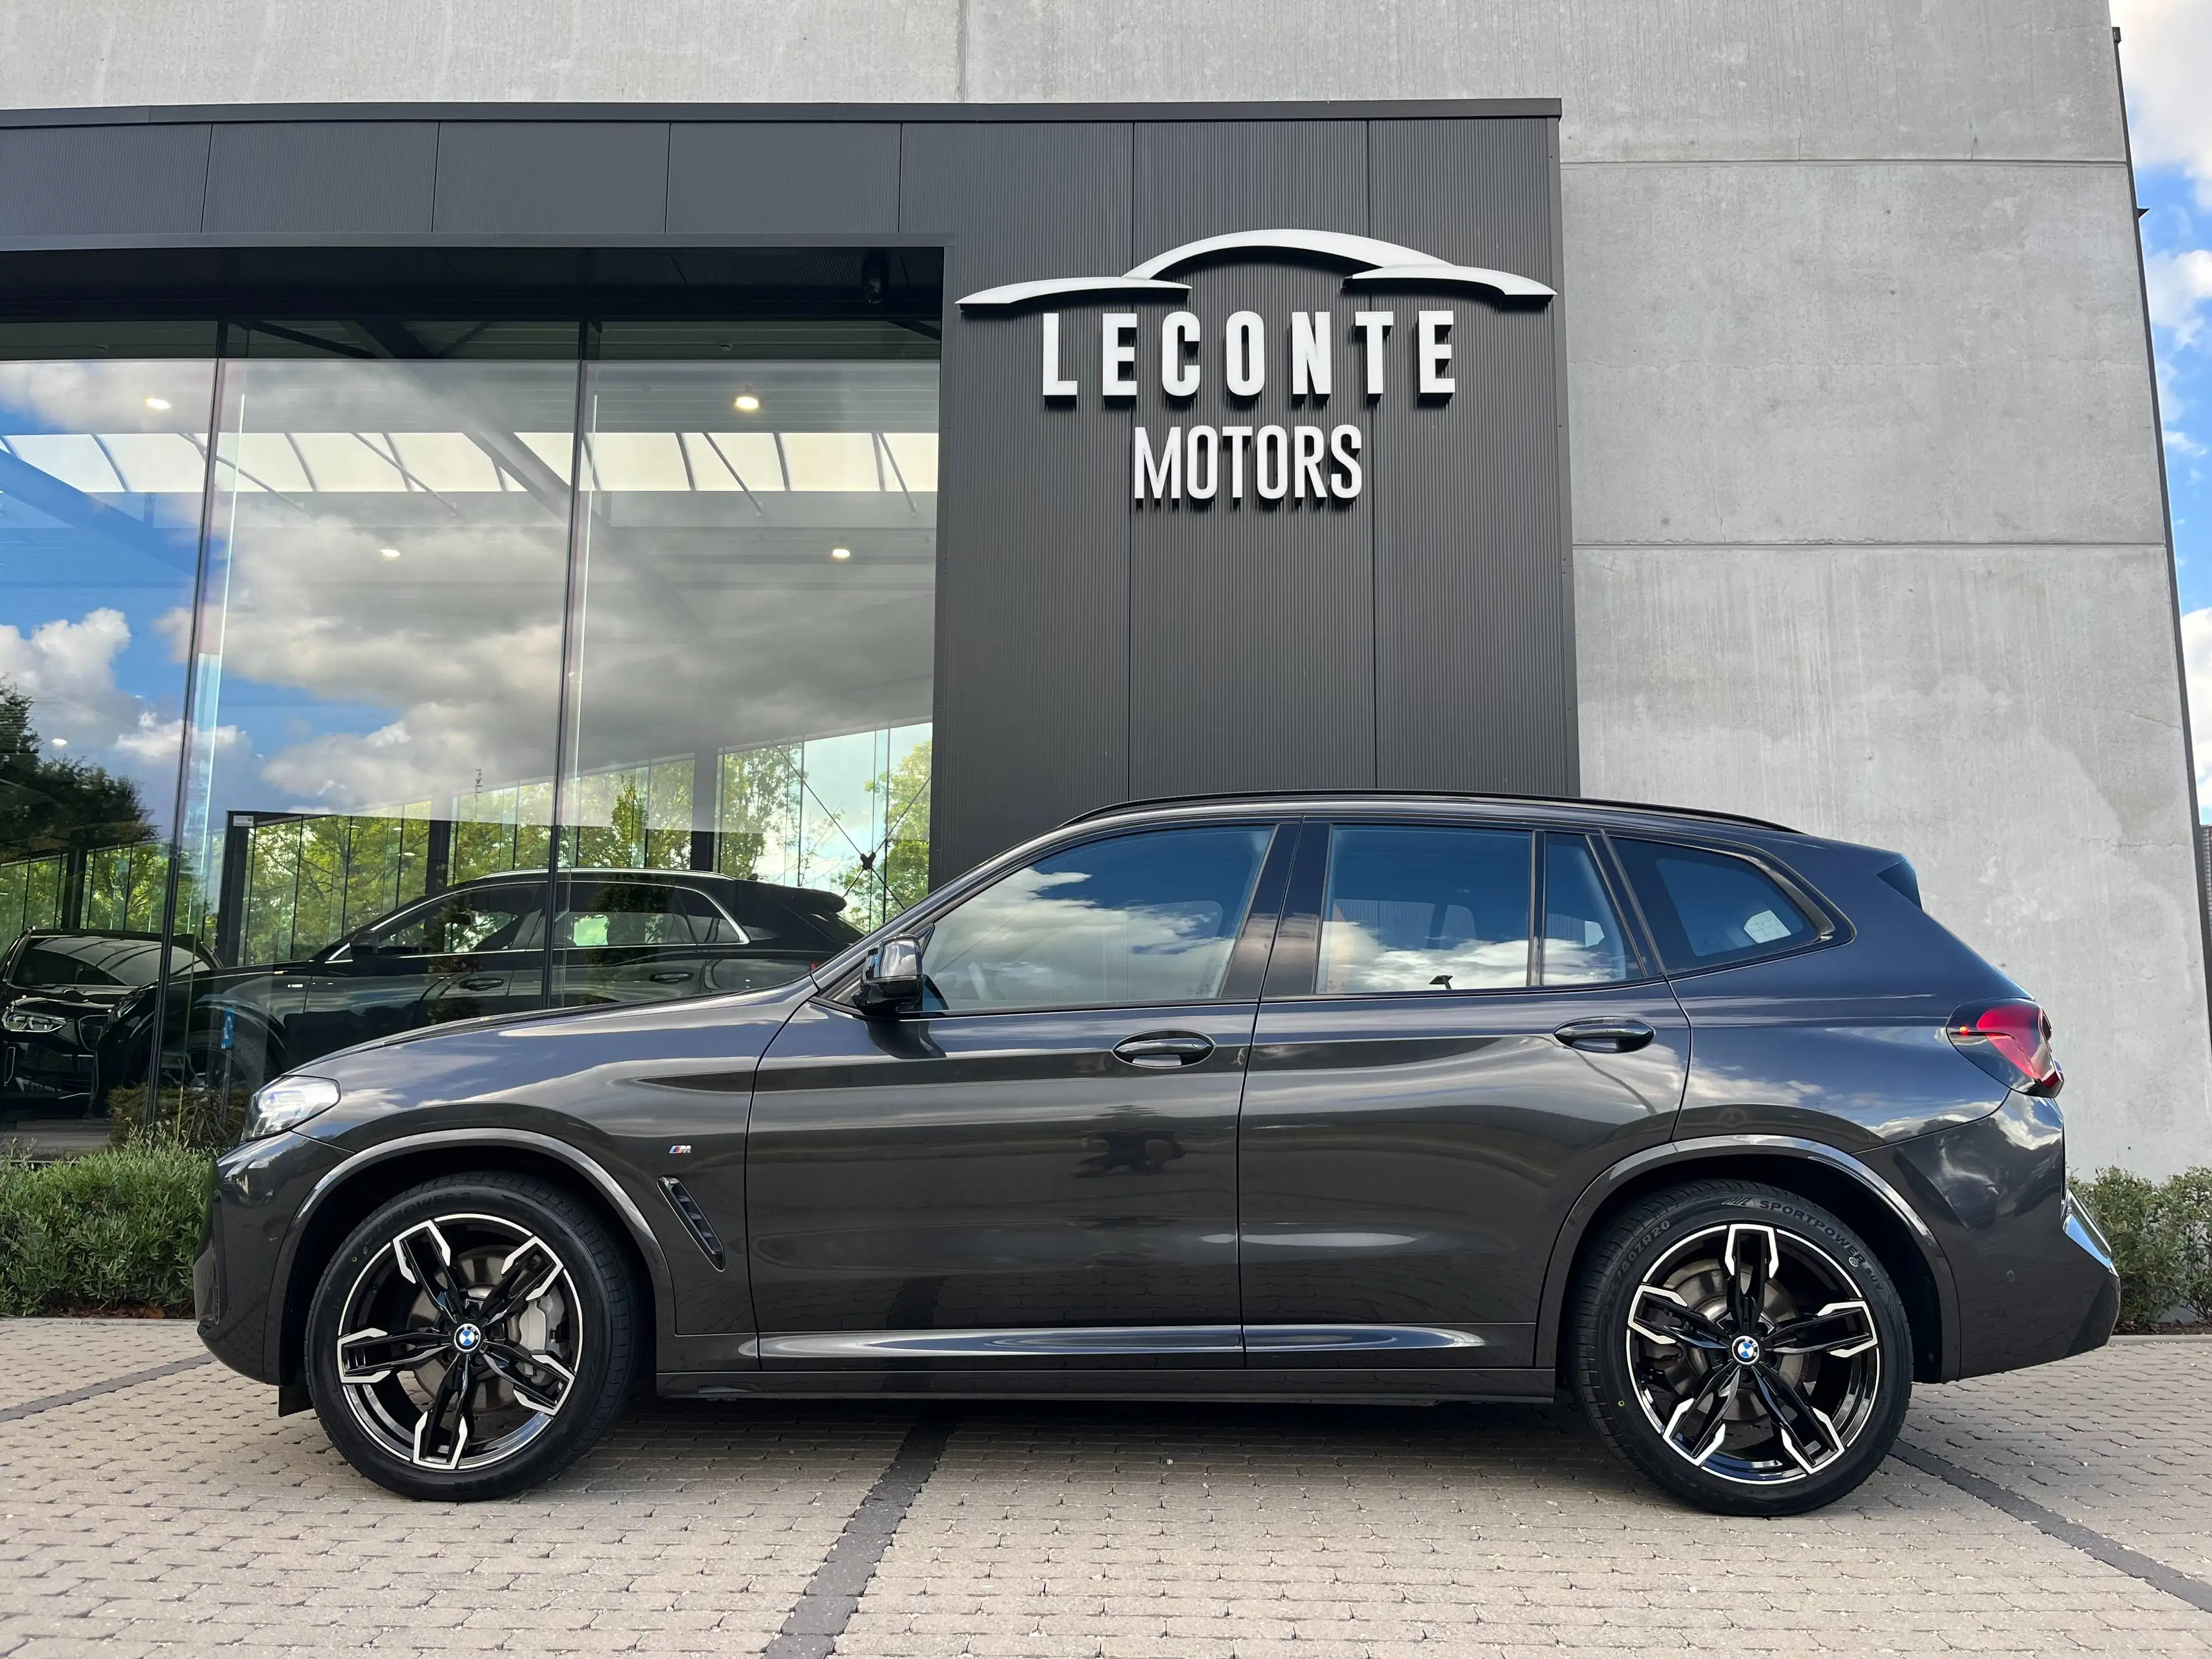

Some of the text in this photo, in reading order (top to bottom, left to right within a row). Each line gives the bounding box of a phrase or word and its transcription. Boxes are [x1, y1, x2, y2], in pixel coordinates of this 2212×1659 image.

[1043, 310, 1455, 399] LECONTE
[1134, 424, 1361, 501] MOTORS
[1759, 1199, 1884, 1290] SPORTPOWER SUV
